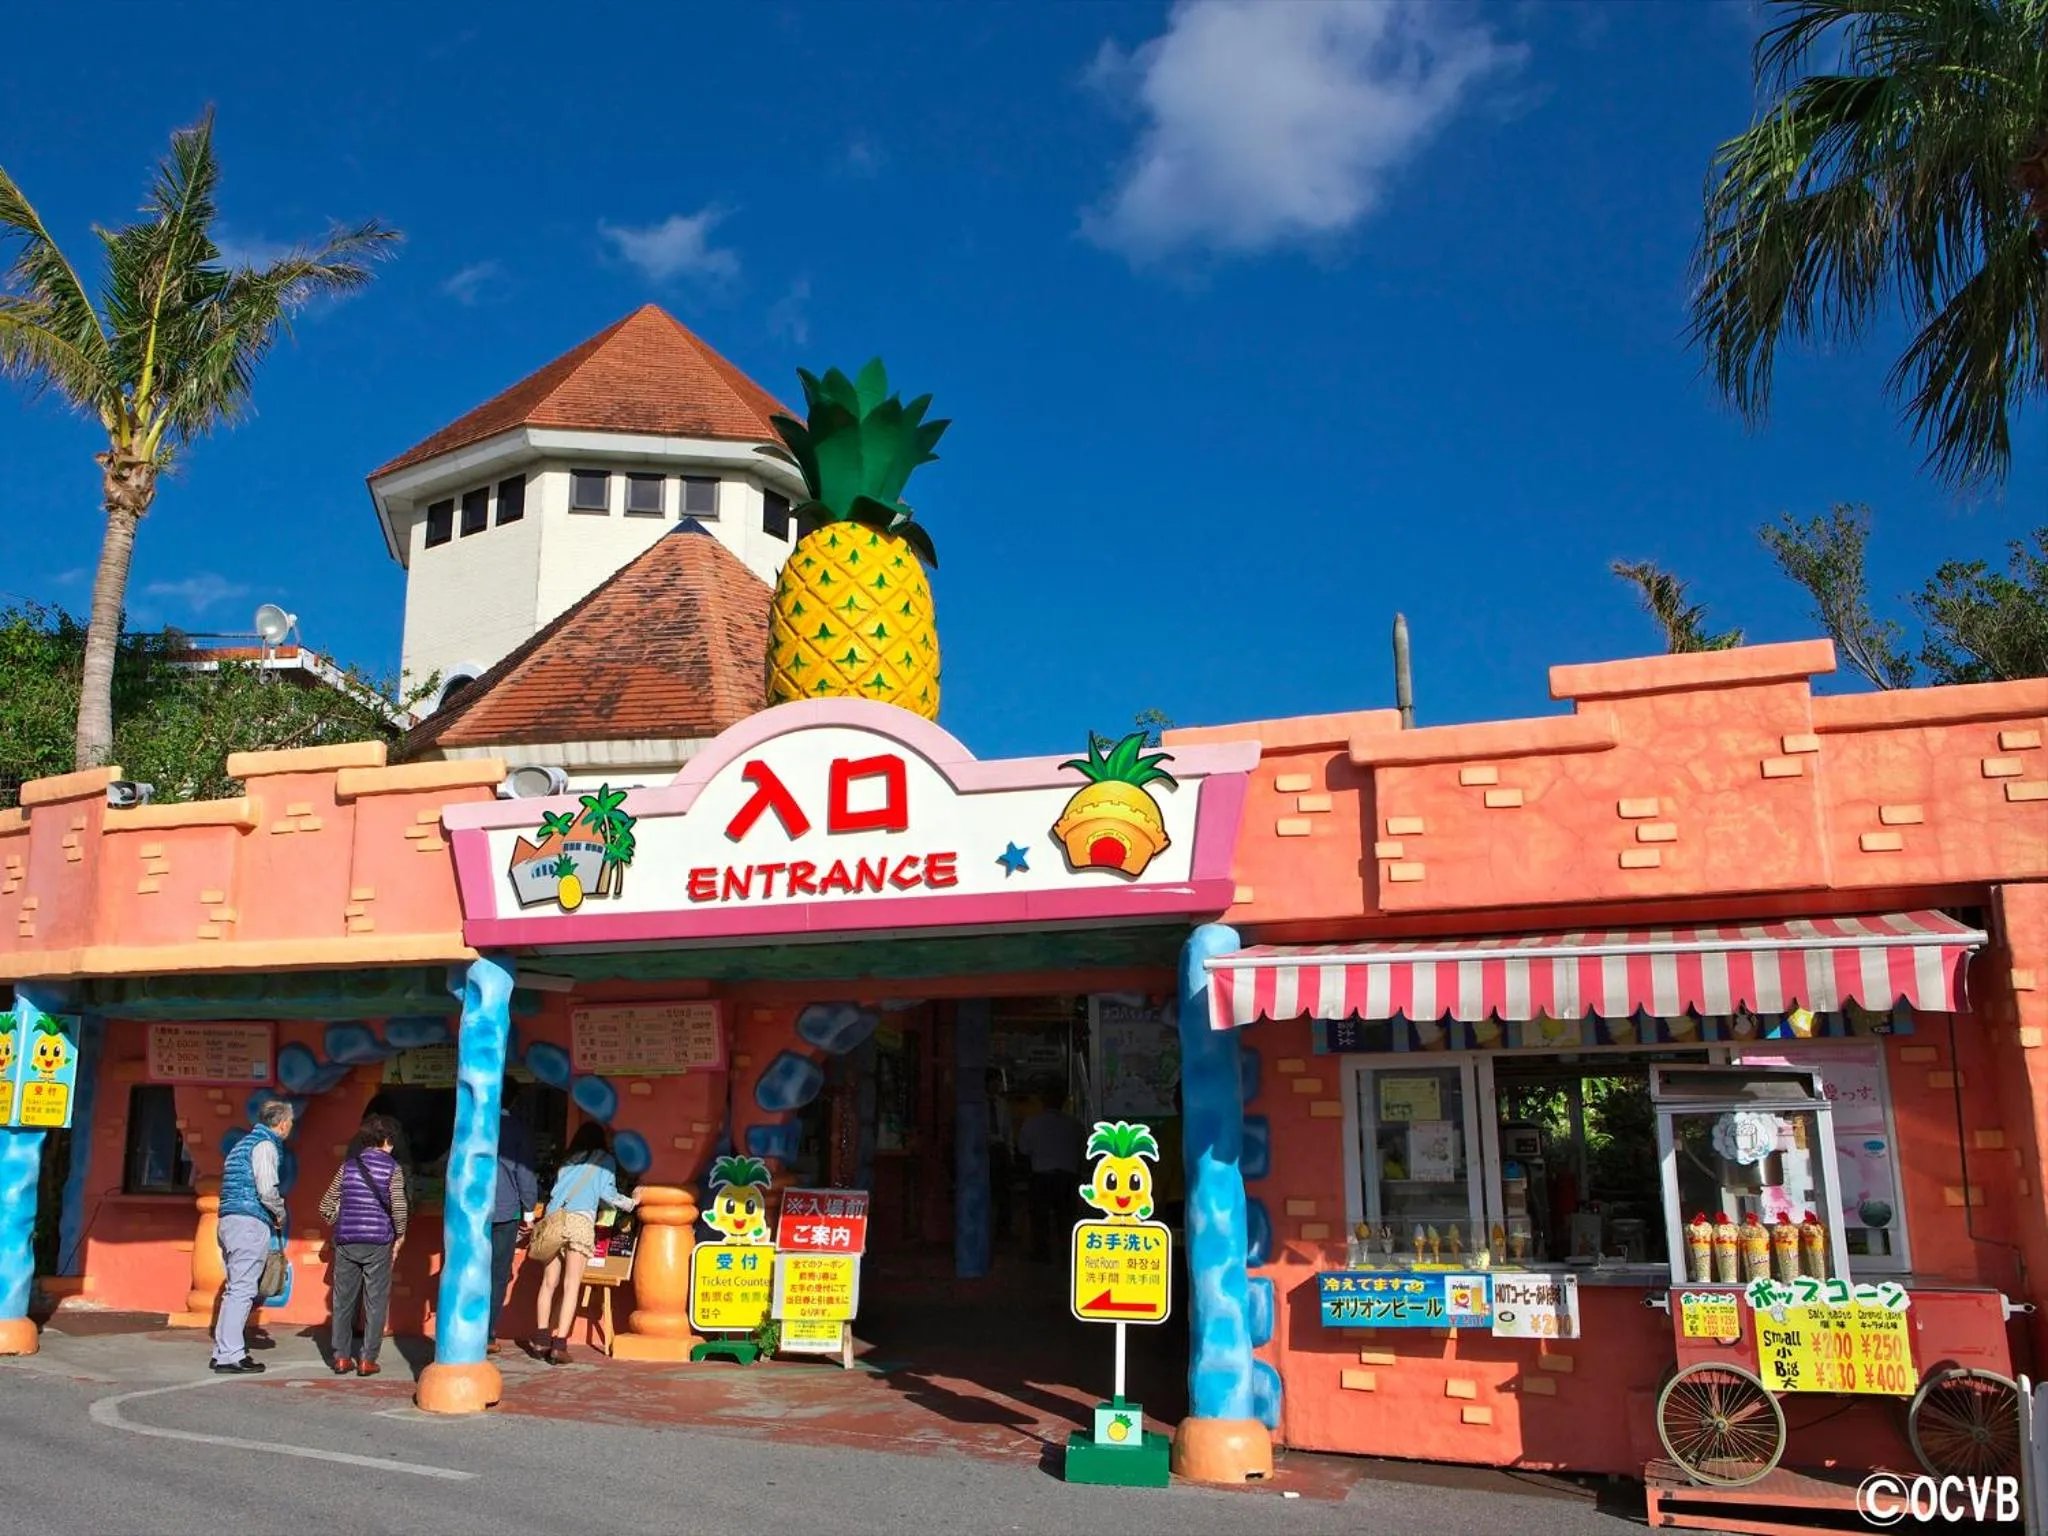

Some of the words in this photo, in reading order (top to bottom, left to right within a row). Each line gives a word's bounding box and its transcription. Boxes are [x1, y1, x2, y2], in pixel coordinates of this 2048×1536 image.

[725, 754, 908, 842] 入口
[687, 852, 958, 901] ENTRANCE
[793, 1225, 850, 1247] ご案内
[1086, 1232, 1160, 1251] お手洗い
[716, 1253, 758, 1270] 受付
[1127, 1258, 1160, 1271] 화장실
[701, 1276, 731, 1287] Ticket
[734, 1276, 771, 1287] Counte
[1324, 1277, 1402, 1292] 冷えてます
[1749, 1278, 1903, 1308] ポップコーン
[1331, 1297, 1443, 1319] オリオンビール
[1763, 1330, 1802, 1347] Small
[1860, 1333, 1903, 1361] ¥250
[1776, 1346, 1792, 1359] 小
[1774, 1360, 1800, 1377] Big
[1863, 1362, 1906, 1392] ¥400
[1780, 1377, 1798, 1389] 大
